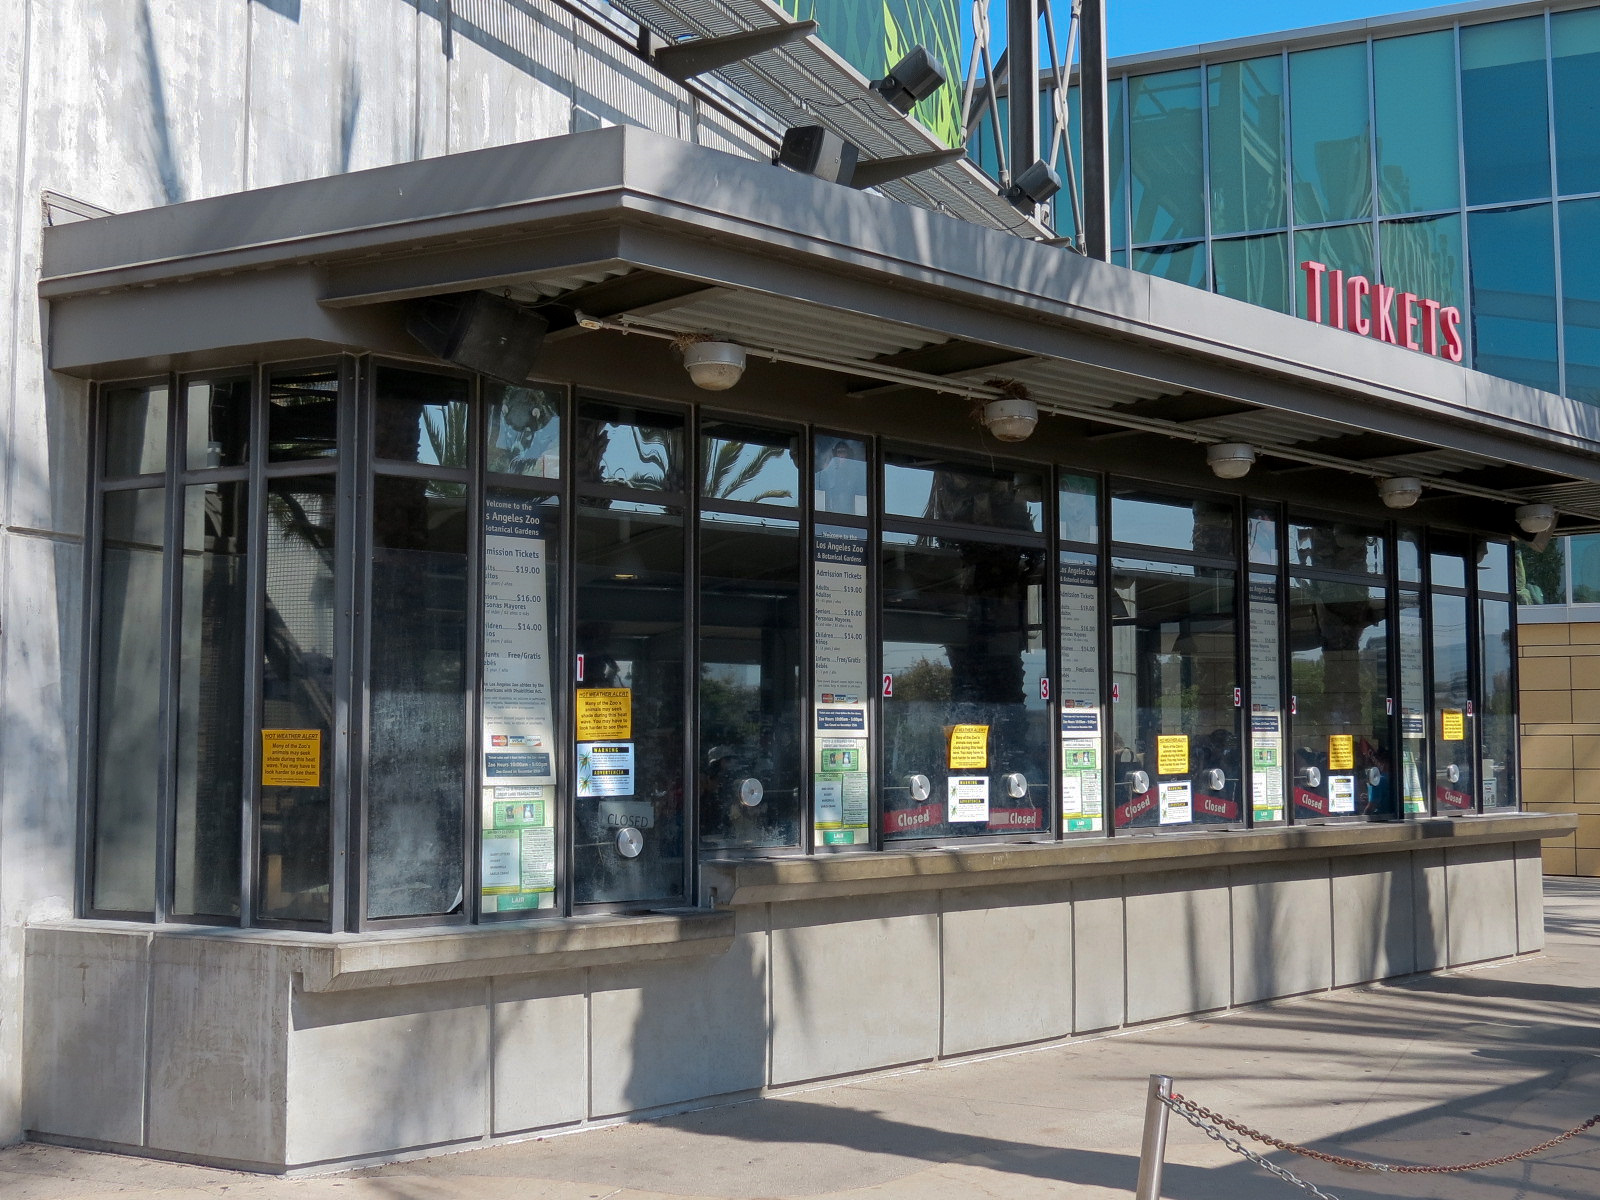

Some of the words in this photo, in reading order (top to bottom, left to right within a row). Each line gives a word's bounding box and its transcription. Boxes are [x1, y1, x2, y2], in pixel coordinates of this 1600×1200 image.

[1301, 260, 1463, 362] TICKETS
[492, 512, 523, 524] Angeles
[525, 515, 540, 524] Zoo
[486, 525, 513, 534] otanical
[514, 527, 539, 536] Gardens
[486, 548, 513, 556] mission
[516, 550, 539, 558] Tickets
[816, 541, 826, 549] Los
[828, 542, 850, 552] Angeles
[852, 545, 864, 553] Zoo
[516, 566, 540, 574] $19.00
[844, 572, 862, 580] Tickets
[1068, 566, 1086, 576] Angeles
[844, 586, 862, 594] $19.00
[517, 594, 541, 602] $16.00
[518, 622, 542, 631] $14.00
[508, 652, 541, 660] Free/Gratis
[578, 656, 583, 678] 1
[884, 675, 892, 696] 2
[1041, 680, 1048, 698] 3
[1112, 684, 1119, 700] 4
[1234, 688, 1240, 706] 5
[1386, 700, 1392, 714] 7
[1468, 702, 1472, 715] 8
[1302, 794, 1322, 810] Closed
[1444, 791, 1462, 804] Closed
[1125, 796, 1150, 818] Closed
[1204, 800, 1226, 814] Closed
[608, 814, 648, 828] CLOSED
[898, 810, 930, 827] Closed
[1009, 812, 1037, 824] Closed
